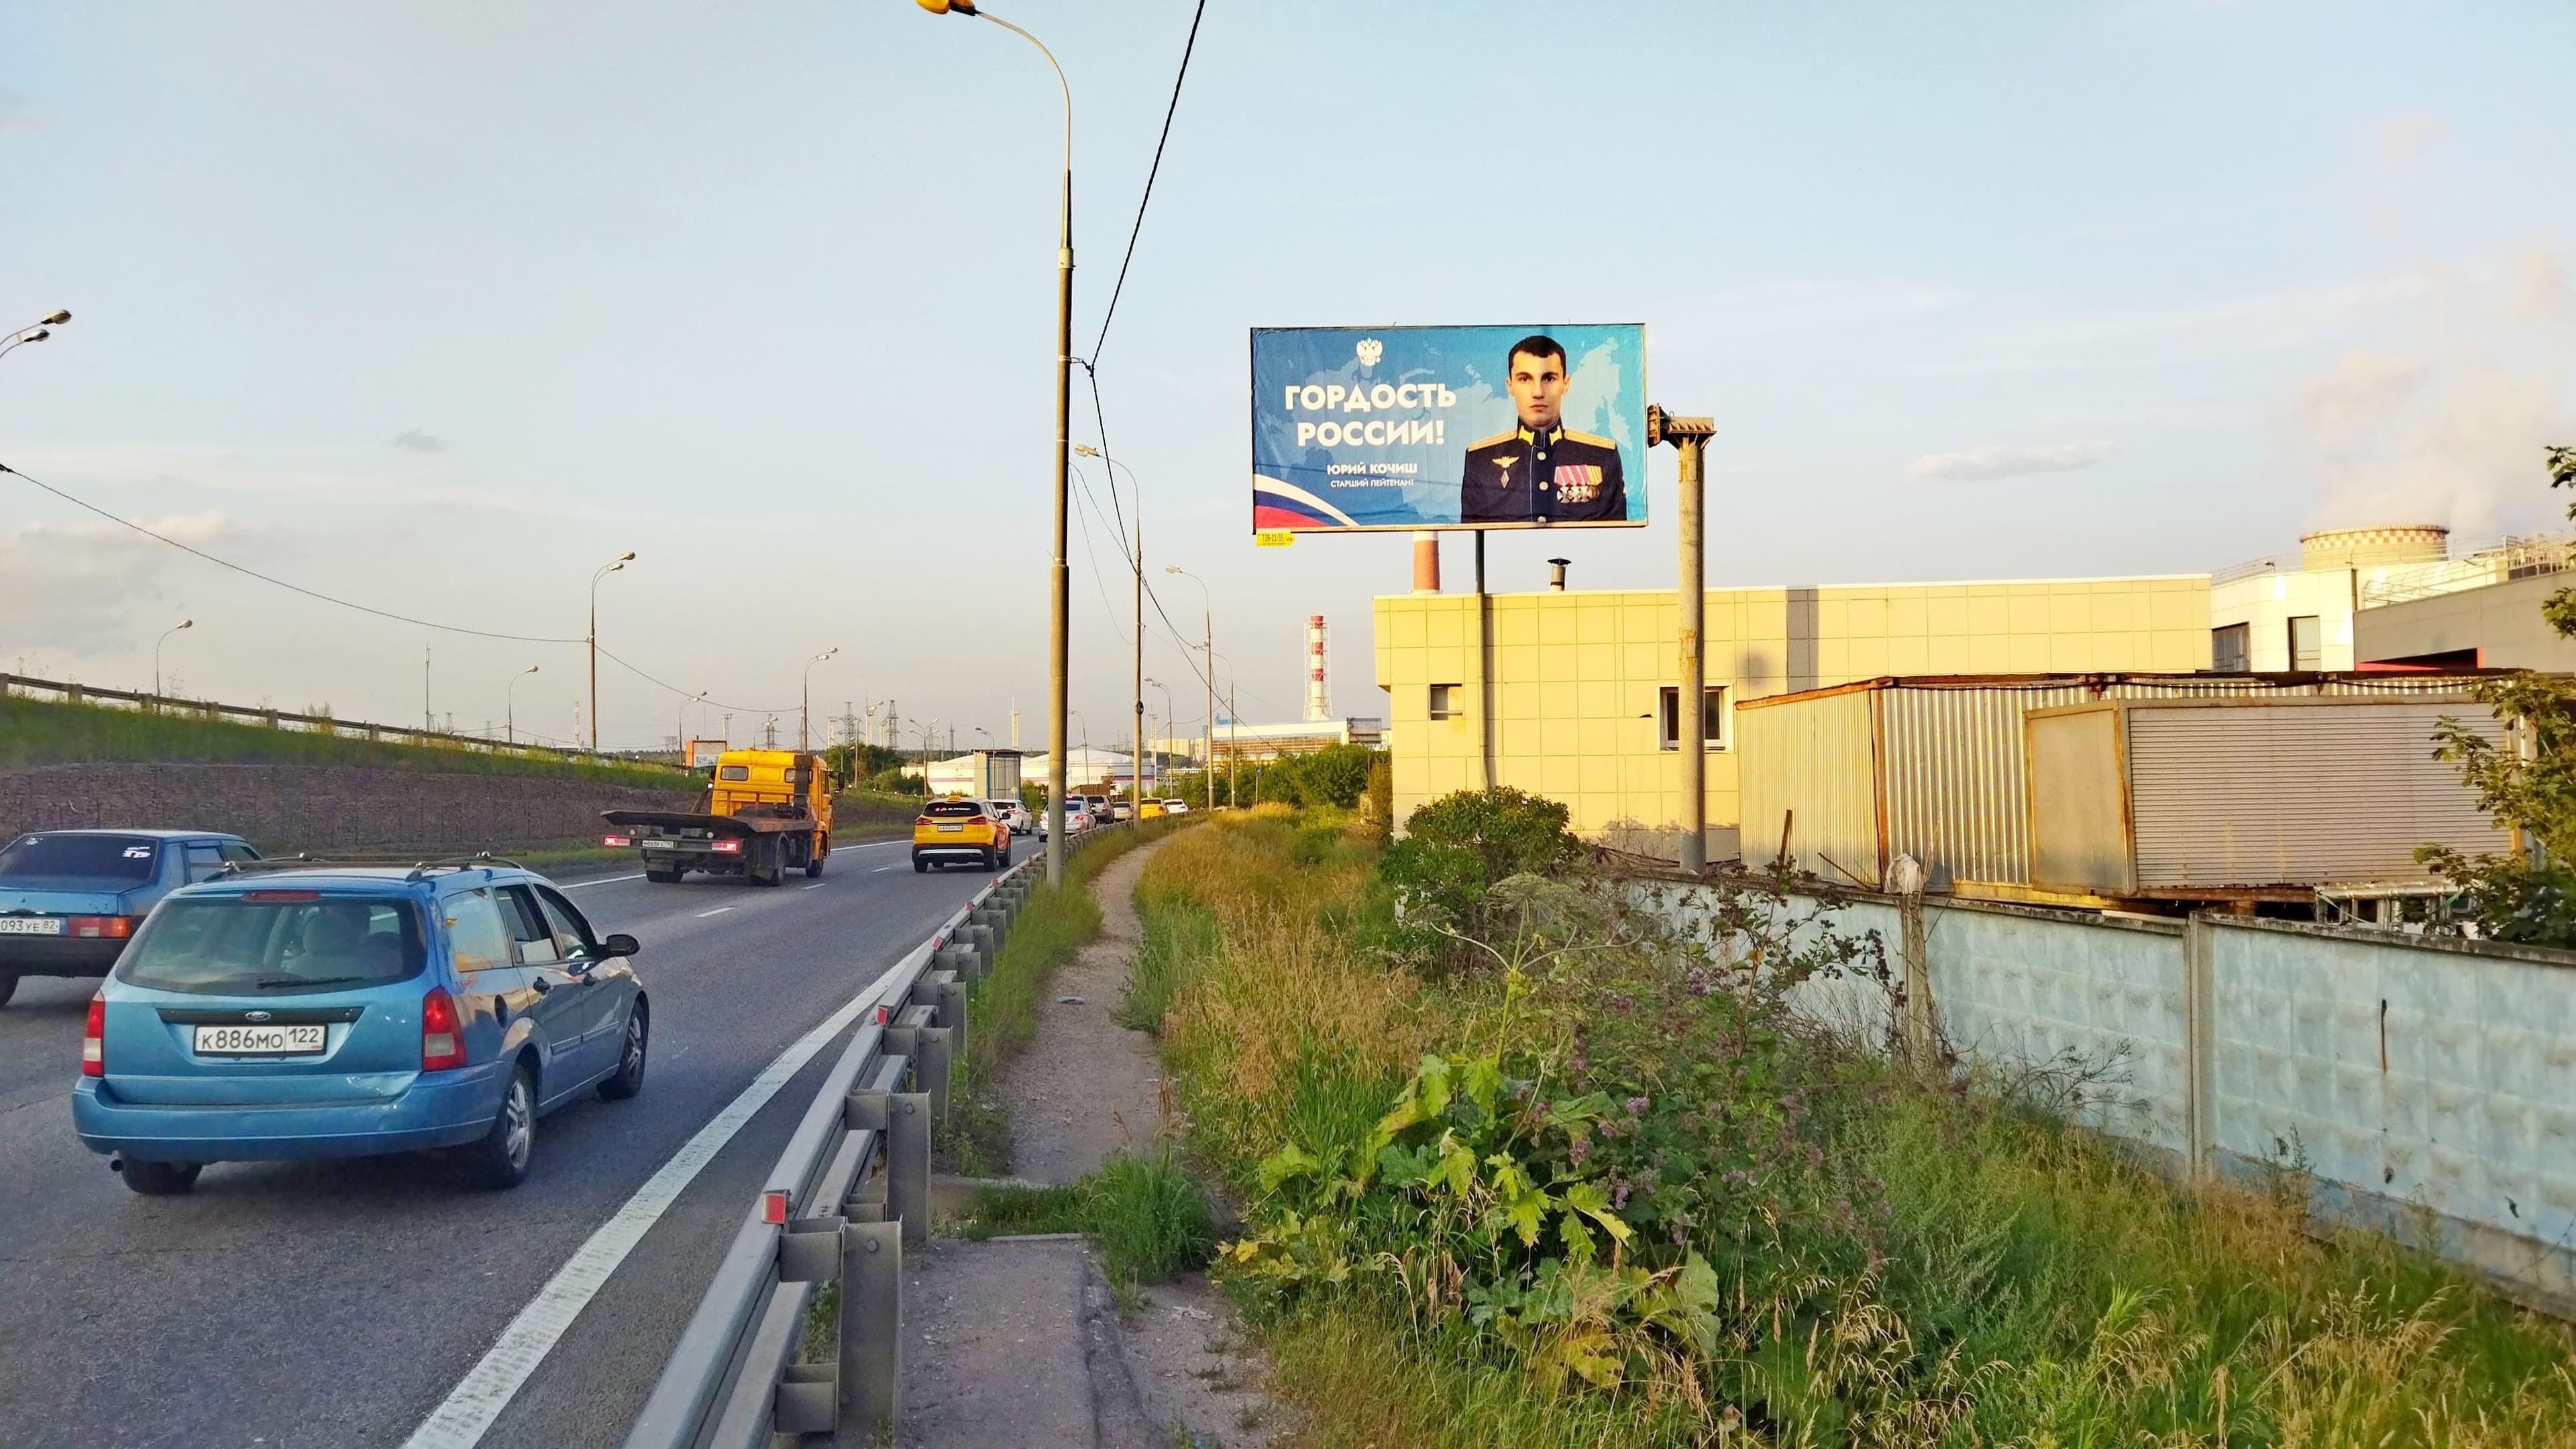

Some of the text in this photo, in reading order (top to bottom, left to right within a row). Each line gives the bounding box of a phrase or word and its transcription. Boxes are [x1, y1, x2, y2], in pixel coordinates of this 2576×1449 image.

[1285, 383, 1456, 413] ГОРДОСТЬ
[1297, 420, 1444, 447] РОССИИ!
[1327, 462, 1417, 475] ЮРИЙ КОЧИШ
[1330, 478, 1414, 488] СТАРШИЙ ЛЕЙТЕНАНТ
[288, 1028, 319, 1043] 122
